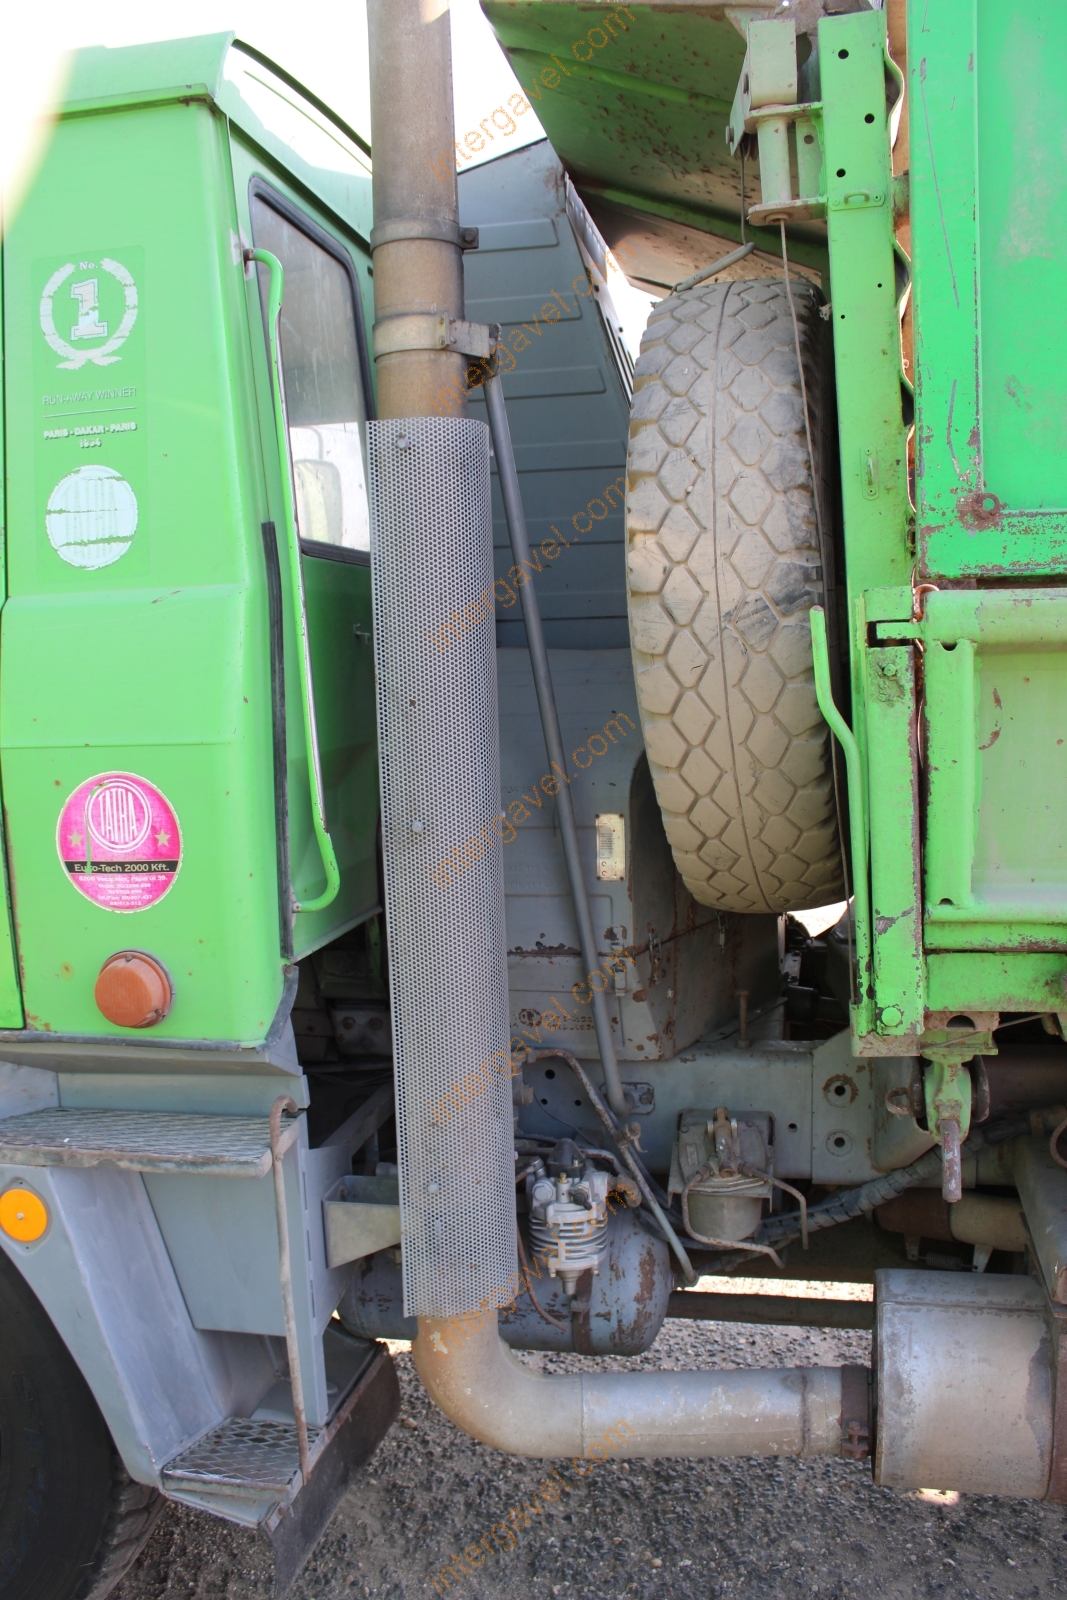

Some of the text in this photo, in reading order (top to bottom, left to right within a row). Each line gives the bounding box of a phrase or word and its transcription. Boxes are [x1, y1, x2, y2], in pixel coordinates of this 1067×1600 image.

[79, 262, 98, 271] No.
[70, 278, 108, 341] 1
[42, 387, 137, 406] RUN-AWAY WINNER
[43, 429, 69, 440] PARIS
[74, 425, 105, 437] DAKAR
[110, 422, 137, 432] PARIS
[99, 789, 137, 842] TATRA
[74, 863, 169, 872] Euo-Tech 2000 Kft.
